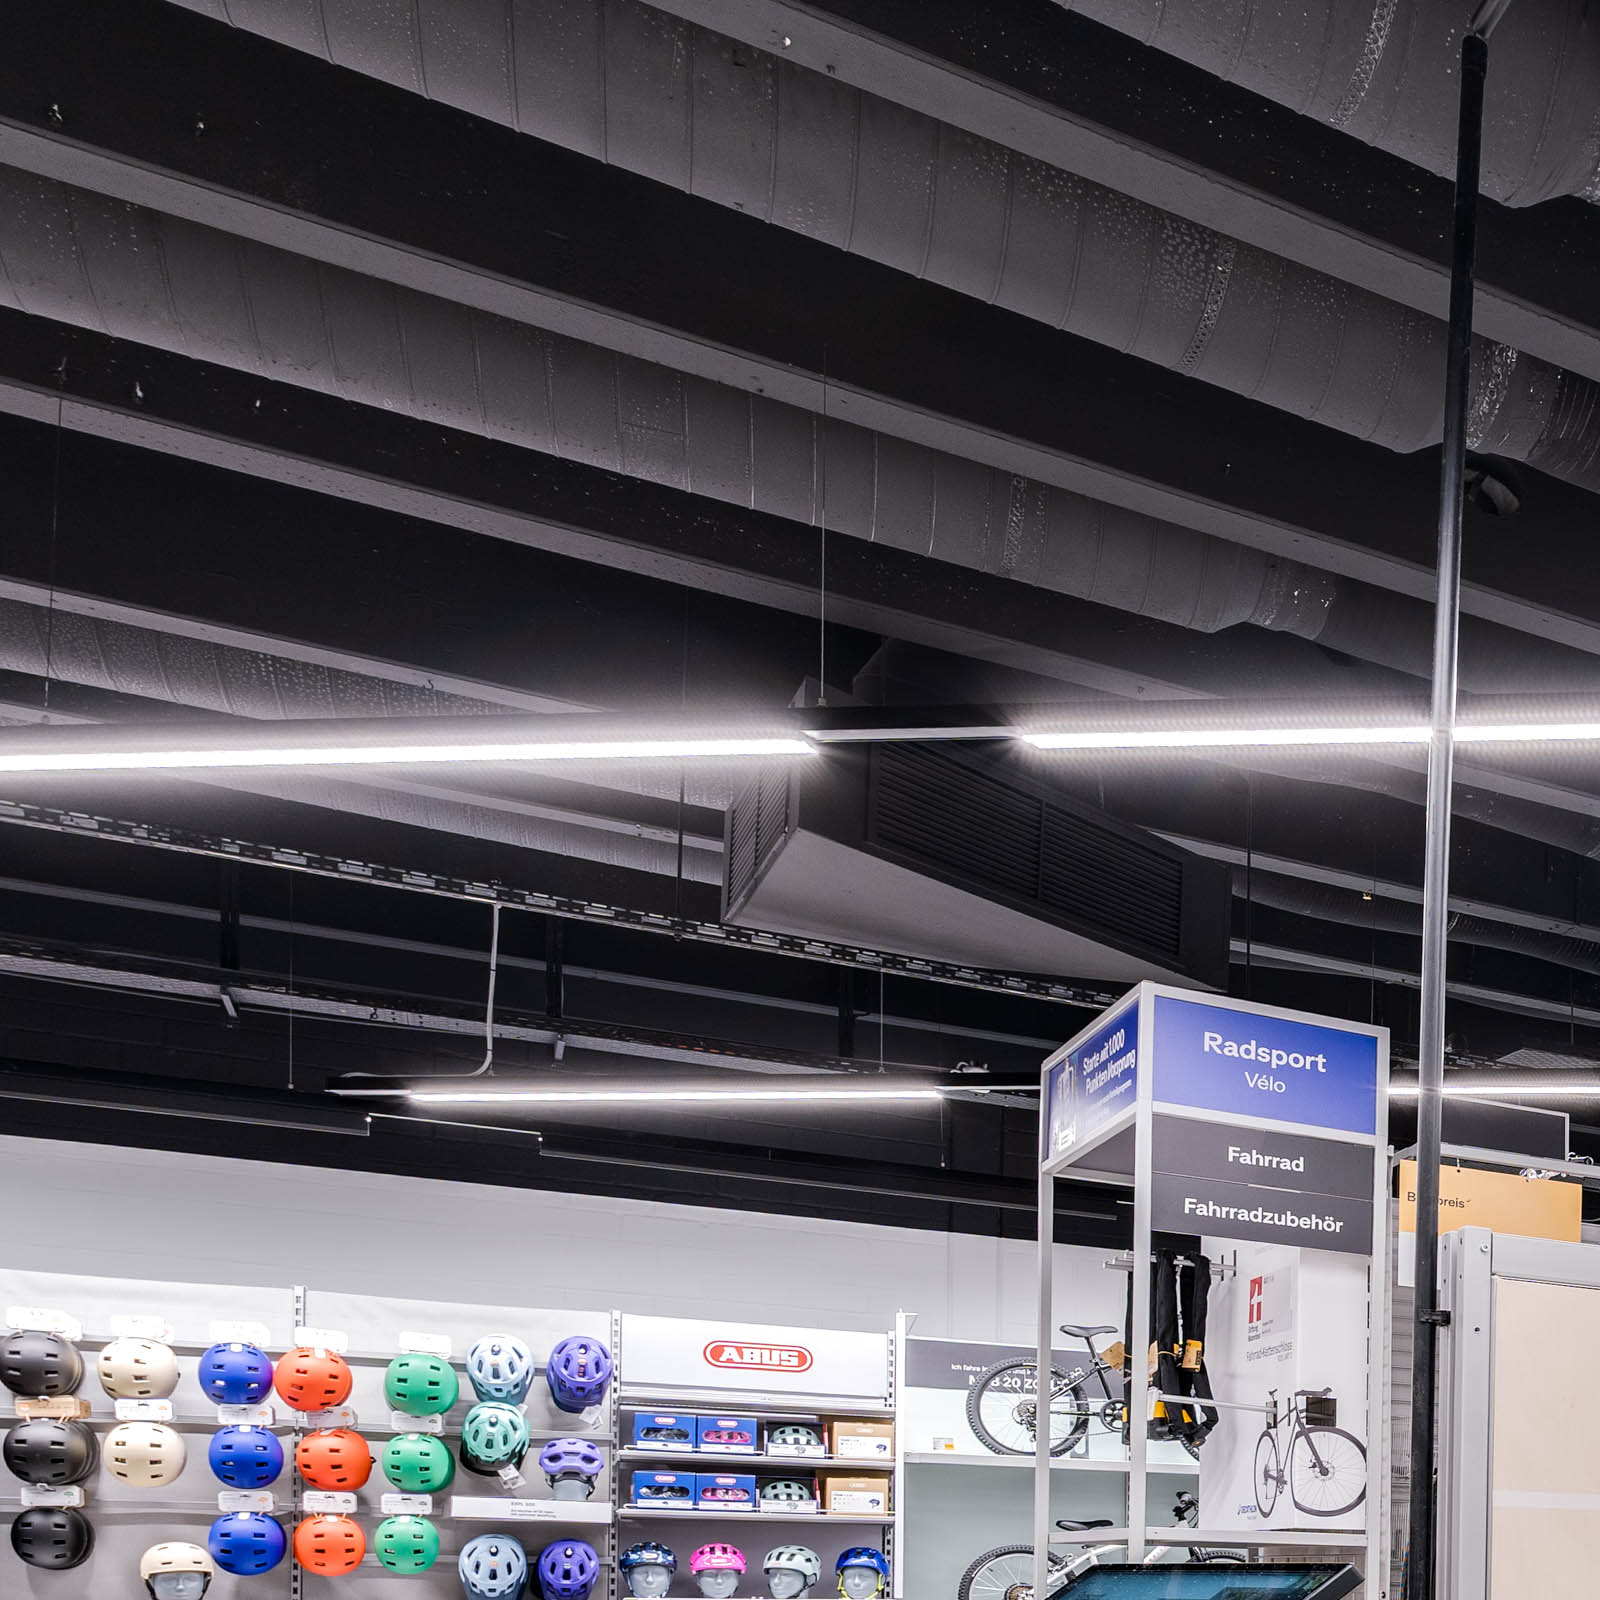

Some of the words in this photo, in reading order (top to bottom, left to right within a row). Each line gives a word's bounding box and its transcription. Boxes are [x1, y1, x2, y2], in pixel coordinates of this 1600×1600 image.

[1203, 1031, 1327, 1073] Radsport
[1244, 1071, 1286, 1093] Vélo
[1228, 1146, 1304, 1173] Fahrrad
[1407, 1191, 1465, 1209] Bpreis
[1183, 1197, 1344, 1236] Fahrradzubehör
[717, 1345, 800, 1368] ABUS
[1002, 1377, 1021, 1388] 20
